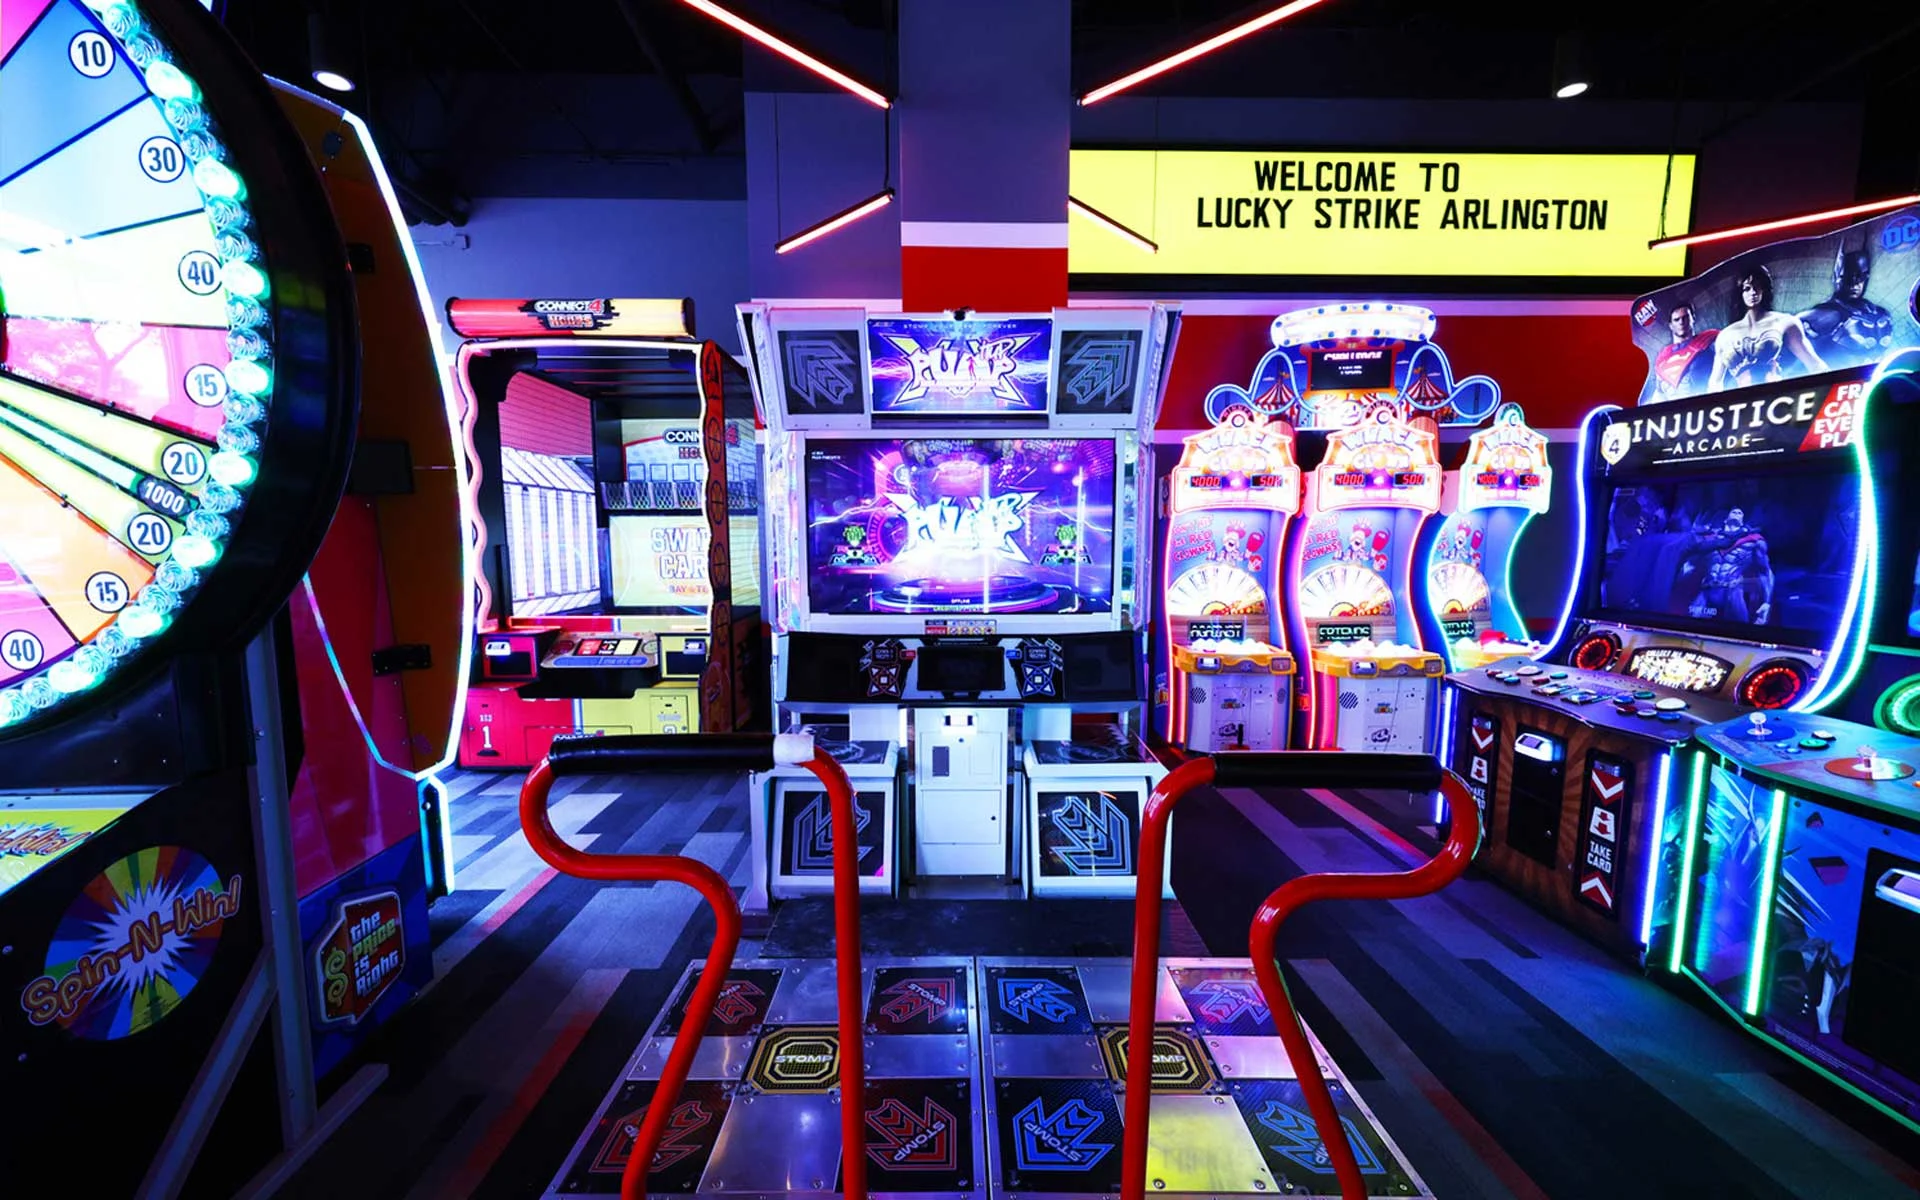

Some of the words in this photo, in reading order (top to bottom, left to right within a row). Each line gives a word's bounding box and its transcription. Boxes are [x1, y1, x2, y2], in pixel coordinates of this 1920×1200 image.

[77, 40, 107, 67] 10
[149, 146, 177, 172] 30
[1255, 161, 1396, 192] WELCOME
[1419, 162, 1460, 193] TO
[1197, 197, 1294, 229] LUCKY
[1315, 198, 1420, 230] STRIKE
[1440, 199, 1608, 231] ARLINGTON
[1886, 222, 1920, 248] DC
[187, 260, 215, 286] 40
[536, 300, 592, 313] CONNECT
[588, 299, 603, 313] 4
[194, 373, 217, 398] 15
[1631, 392, 1815, 443] INJUSTICE
[1814, 415, 1853, 435] EVE
[1608, 439, 1620, 455] 4
[1672, 433, 1752, 455] ARCADE
[169, 450, 199, 476] 20
[143, 482, 186, 513] 1000
[136, 521, 165, 546] 20
[1189, 529, 1212, 544] RED
[659, 554, 707, 579] CAR
[94, 580, 120, 603] 15
[9, 638, 35, 662] 40
[482, 725, 493, 749] 1
[1586, 852, 1613, 874] CARD
[1588, 840, 1613, 861] TAKE
[22, 874, 241, 1025] Spin-N-Win!
[354, 954, 370, 978] is
[907, 983, 946, 1007] STOMP
[1008, 982, 1044, 1007] STOMP
[774, 1053, 833, 1065] STOMP
[893, 1120, 946, 1162] STOMP
[1024, 1122, 1083, 1162] STOMP
